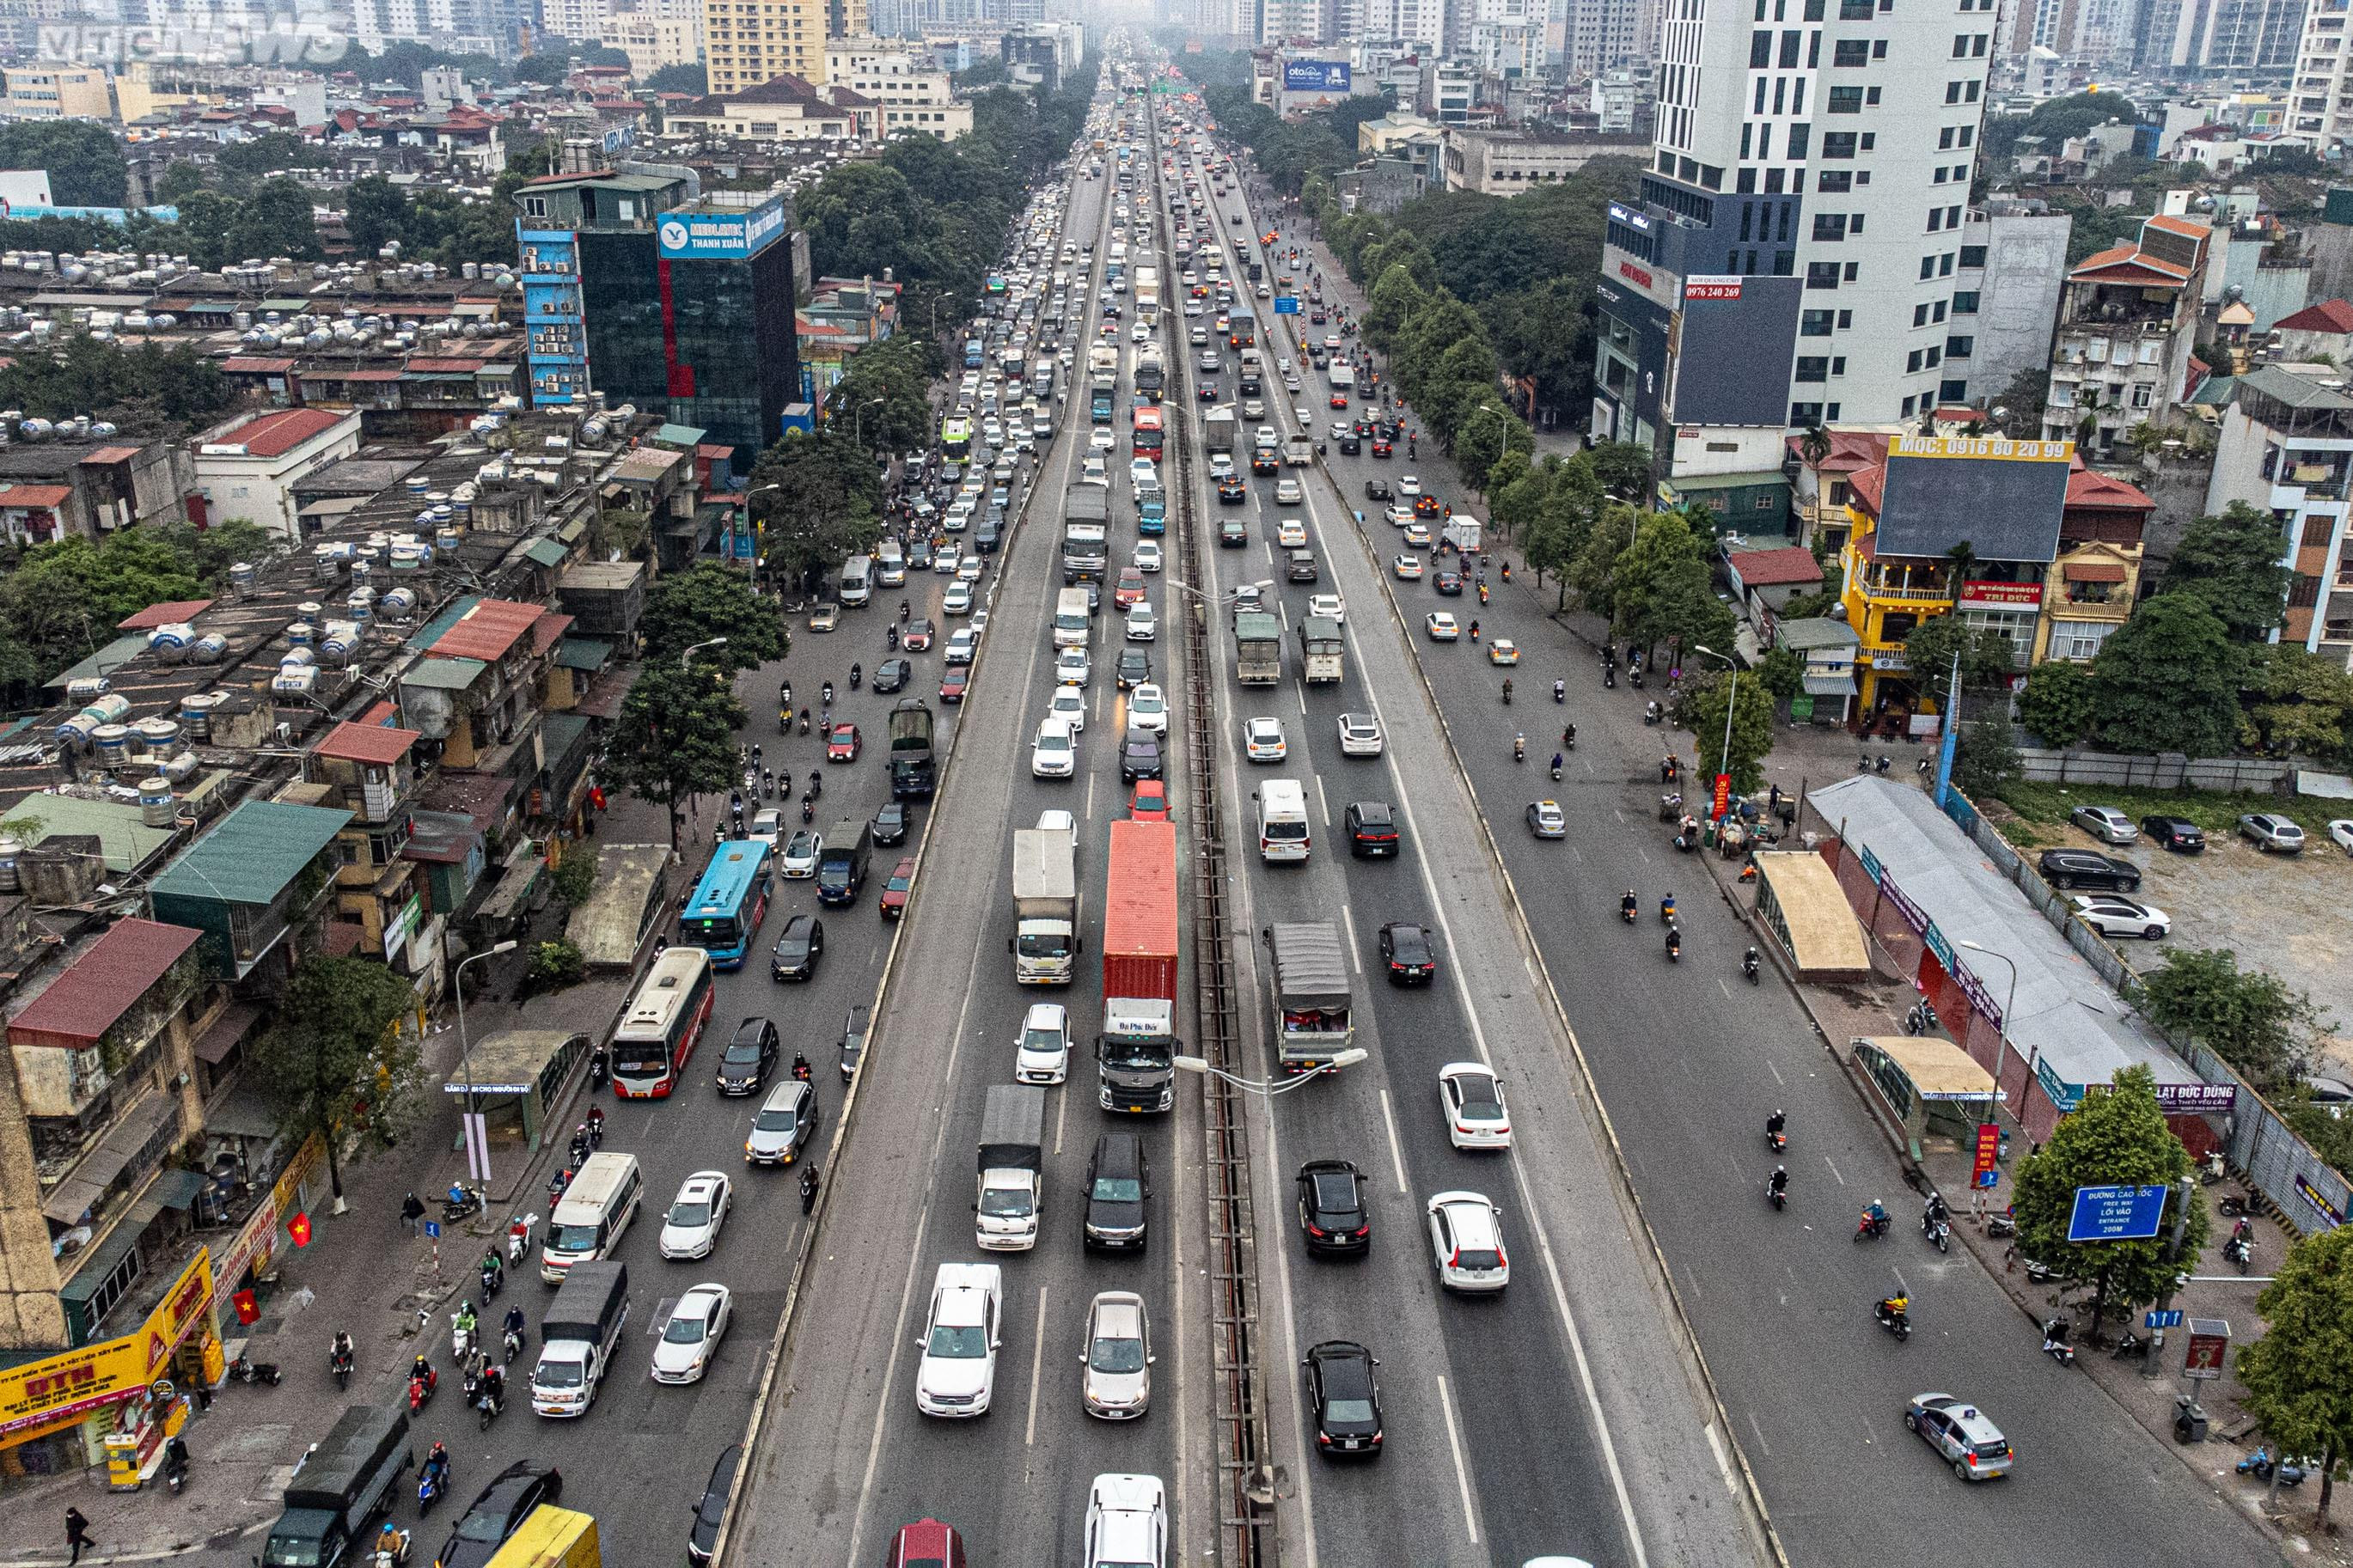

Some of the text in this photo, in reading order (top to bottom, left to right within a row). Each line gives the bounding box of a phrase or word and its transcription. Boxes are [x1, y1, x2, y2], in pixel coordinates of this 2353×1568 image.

[690, 224, 743, 236] MEDLATEC
[691, 237, 744, 248] THANH XUÂN
[1686, 287, 1739, 297] 0976 240 269
[1898, 438, 2065, 457] MQC: 0916 80 20 99
[2156, 1084, 2234, 1099] LẠT ĐỨC DŨNG
[2087, 1191, 2115, 1199] ĐƯỜNG
[2100, 1206, 2131, 1216] LỐI VÀO
